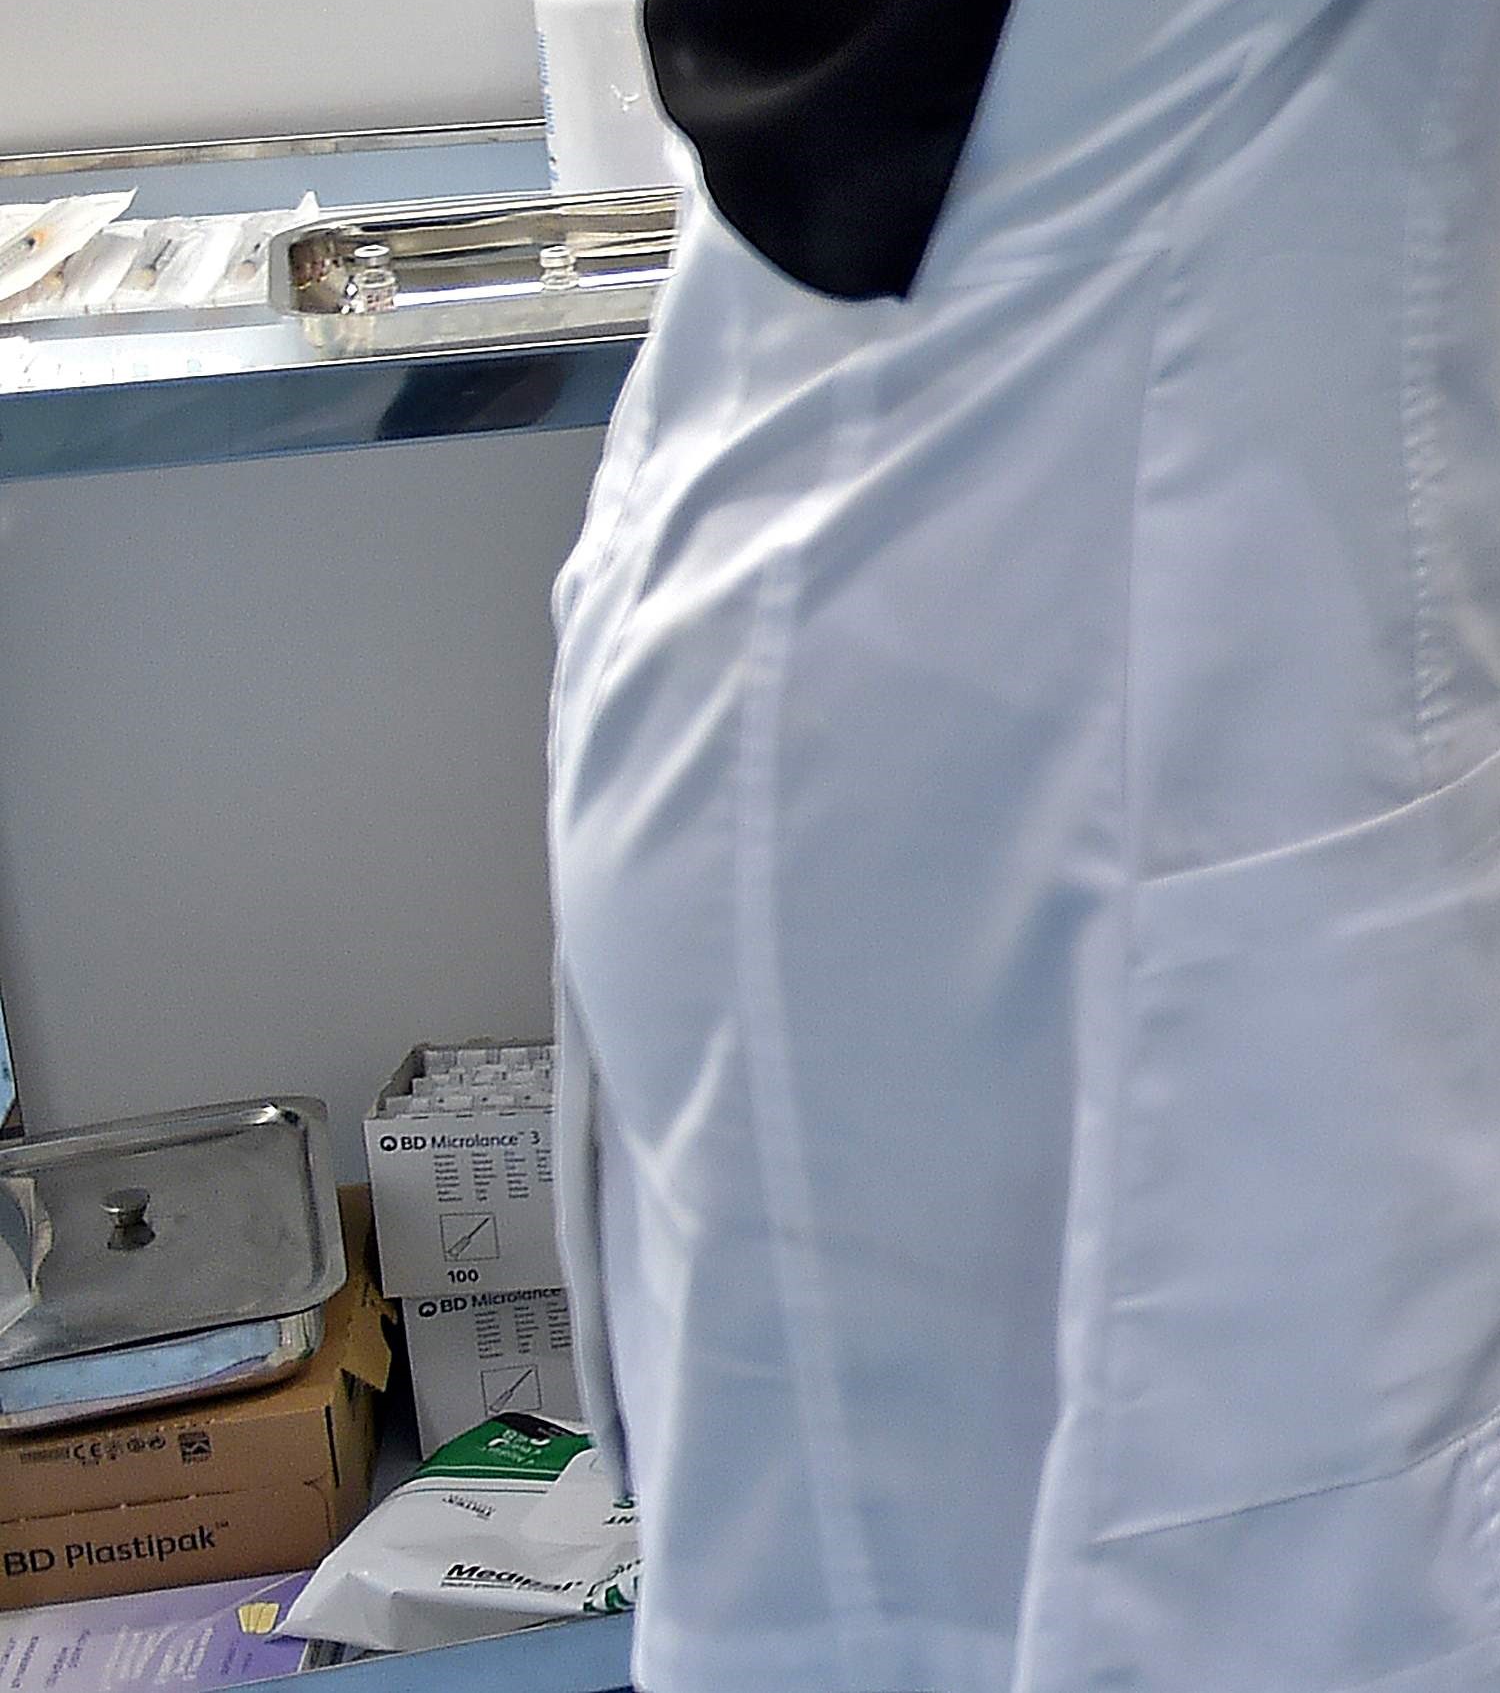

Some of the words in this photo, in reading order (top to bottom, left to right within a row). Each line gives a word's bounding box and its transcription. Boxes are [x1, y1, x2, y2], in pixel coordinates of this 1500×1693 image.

[401, 1136, 427, 1150] BD
[530, 1130, 541, 1145] 3
[448, 1268, 479, 1283] 100
[440, 1297, 467, 1313] BD
[4, 1548, 55, 1577] BD
